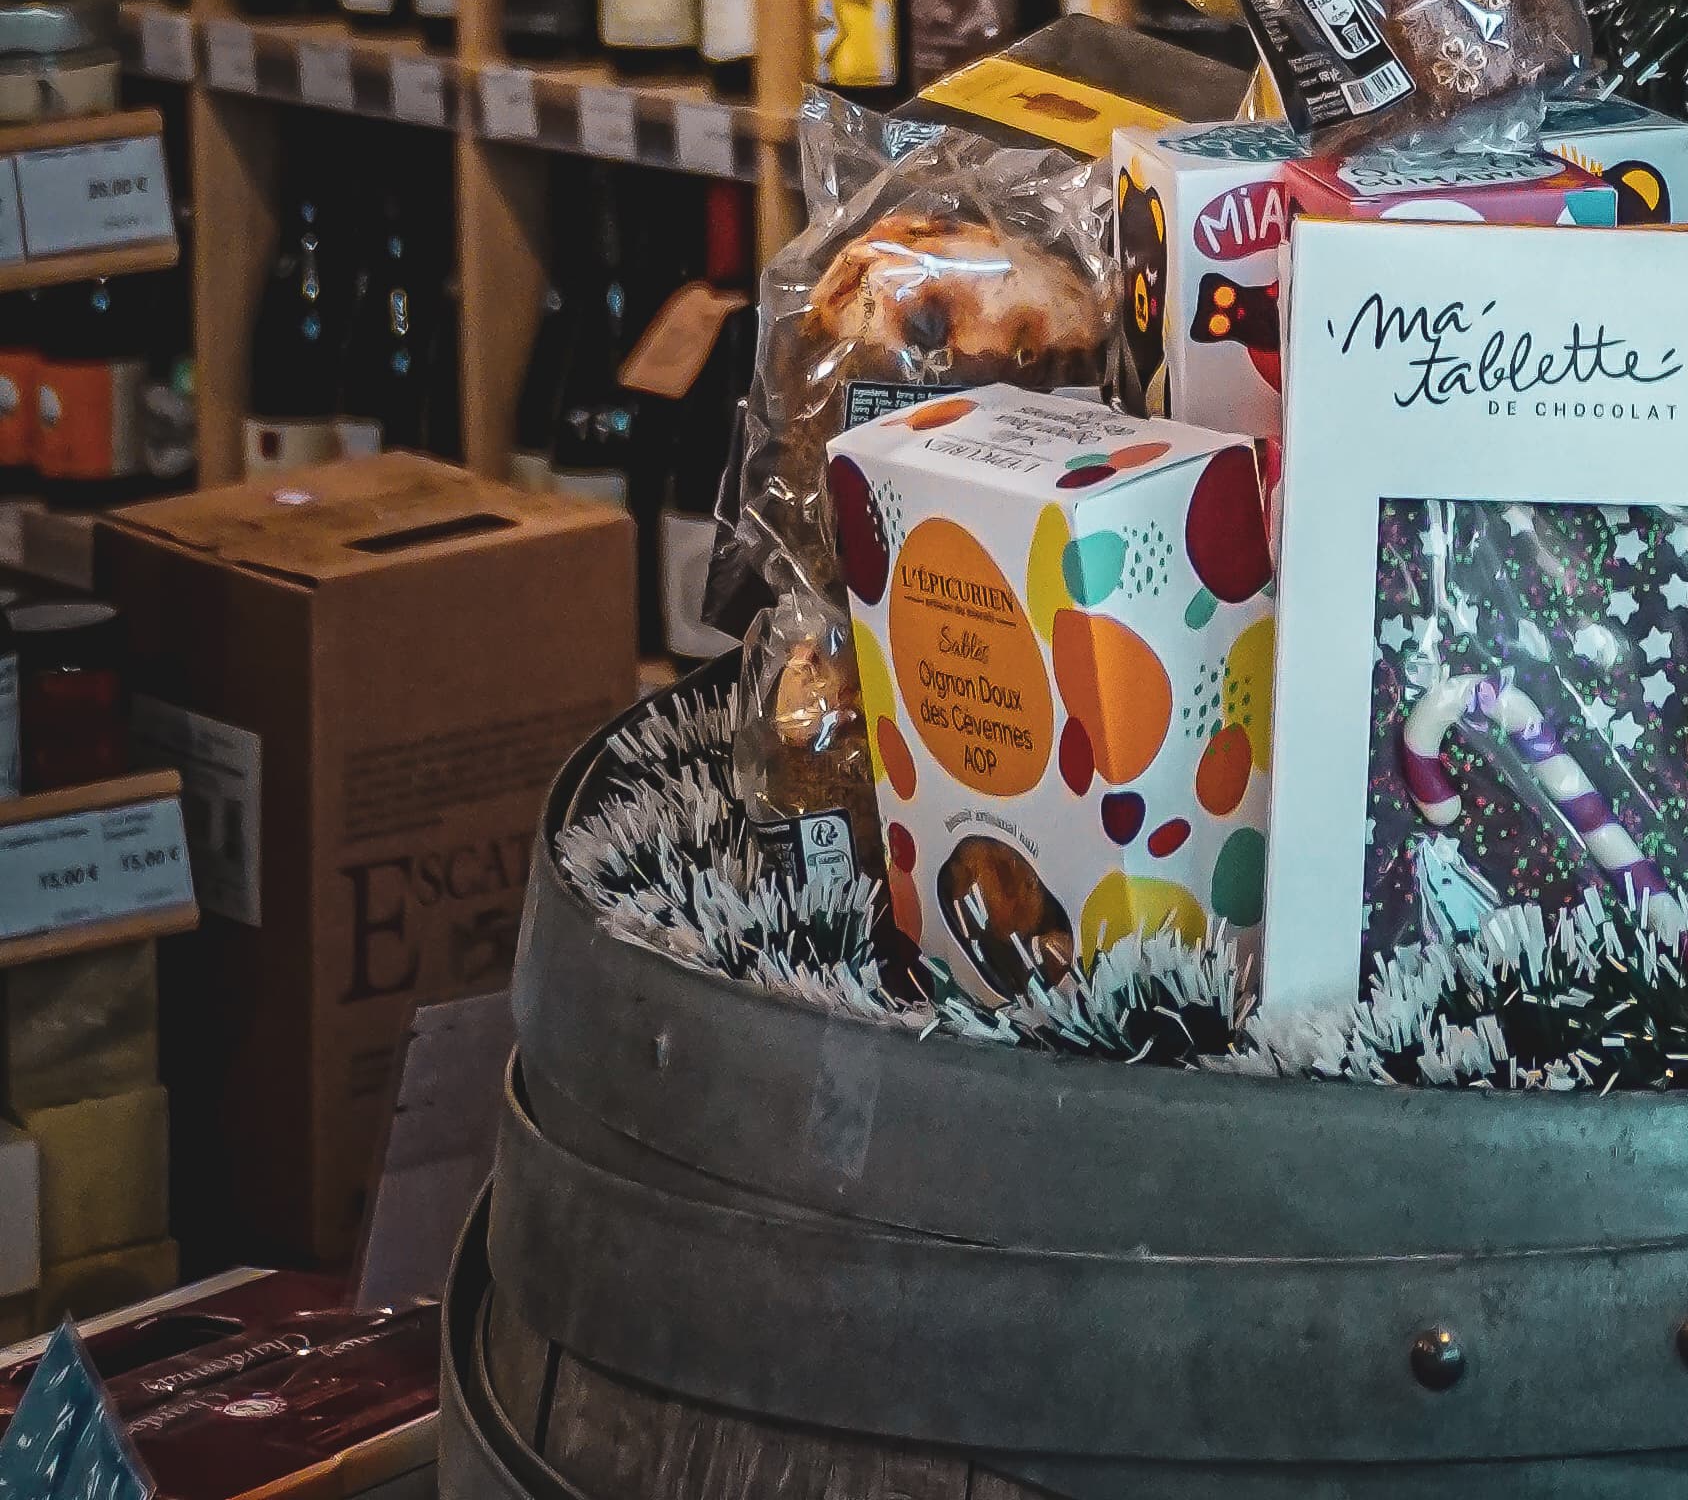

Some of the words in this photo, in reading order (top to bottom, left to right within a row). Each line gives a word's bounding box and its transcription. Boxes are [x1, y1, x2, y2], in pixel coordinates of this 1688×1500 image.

[1488, 399, 1517, 416] DE
[1535, 401, 1678, 421] CHOCOLAT
[902, 564, 1015, 614] L'ÉPICURIEN
[919, 659, 976, 699] Oignon
[980, 675, 1023, 712] Doux
[920, 698, 949, 729] des
[951, 704, 1034, 752] Cévennes
[964, 743, 997, 776] AOP
